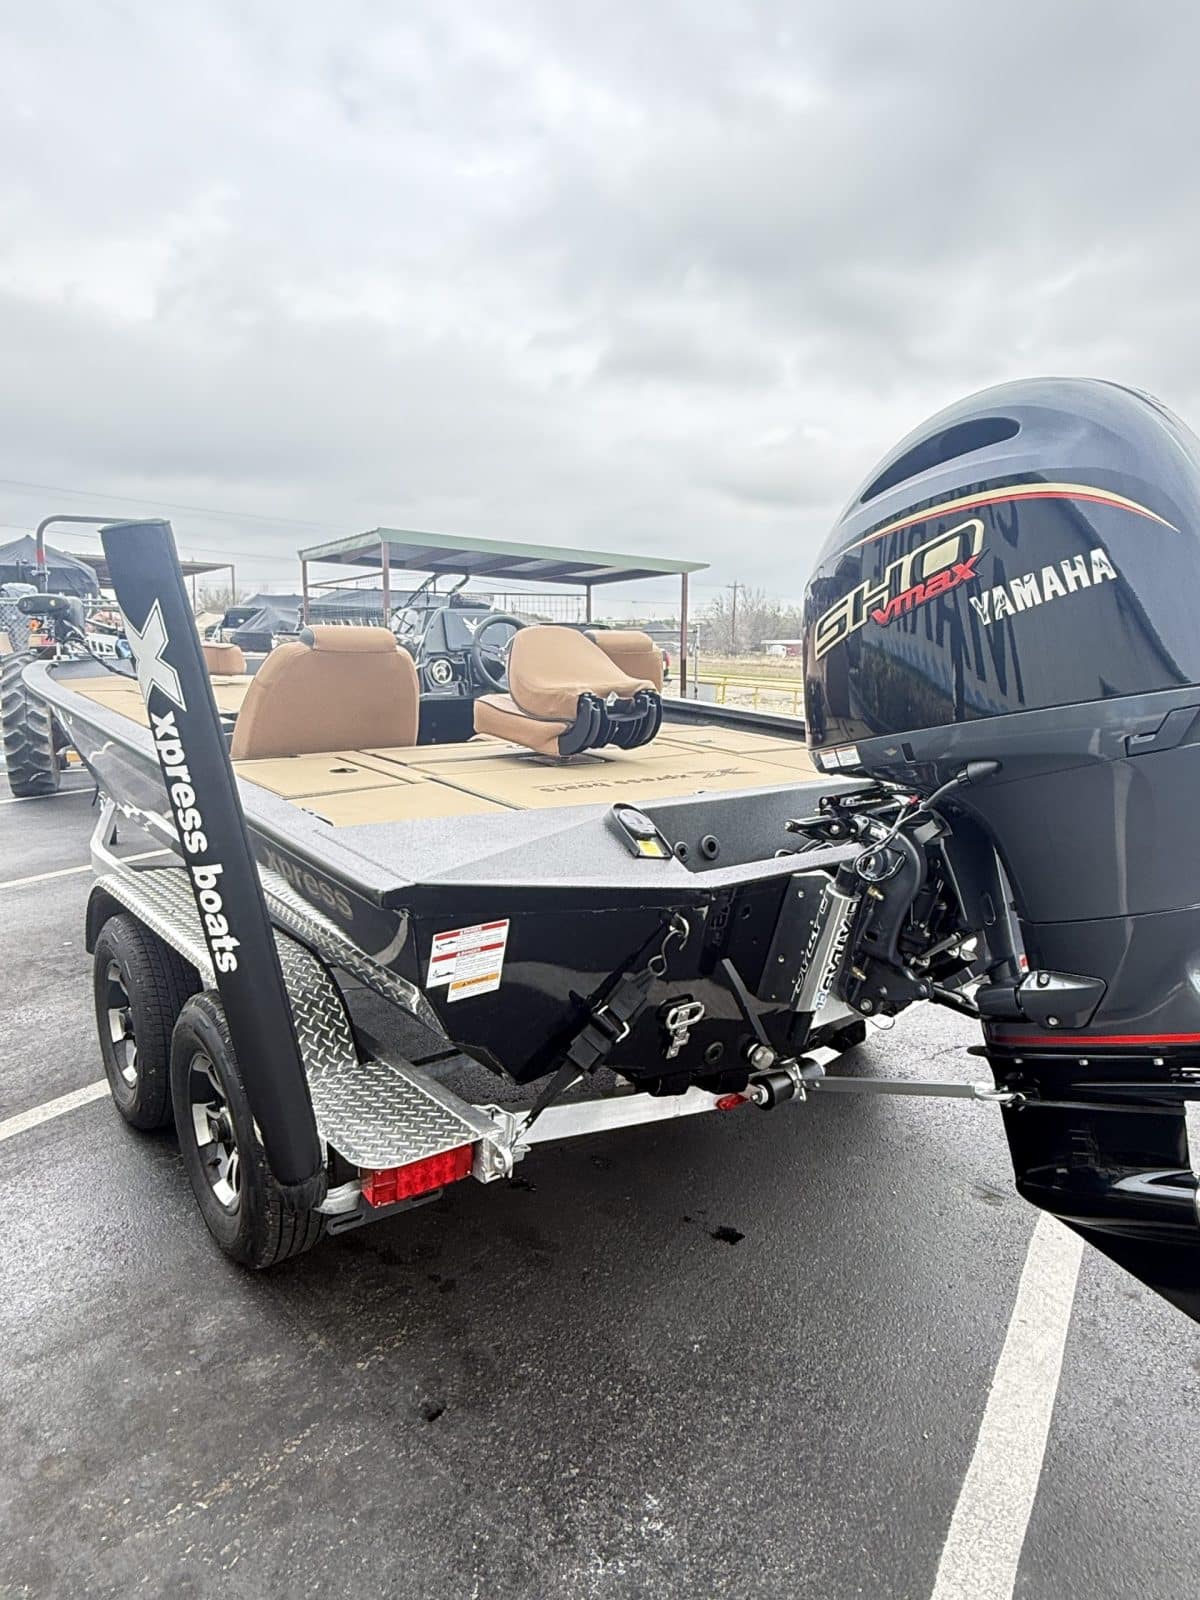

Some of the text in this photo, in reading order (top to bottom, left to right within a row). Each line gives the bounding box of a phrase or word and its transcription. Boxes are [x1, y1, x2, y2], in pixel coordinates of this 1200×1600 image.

[968, 548, 1118, 626] YAMAHA
[150, 710, 209, 854] xpress
[191, 863, 241, 973] boats
